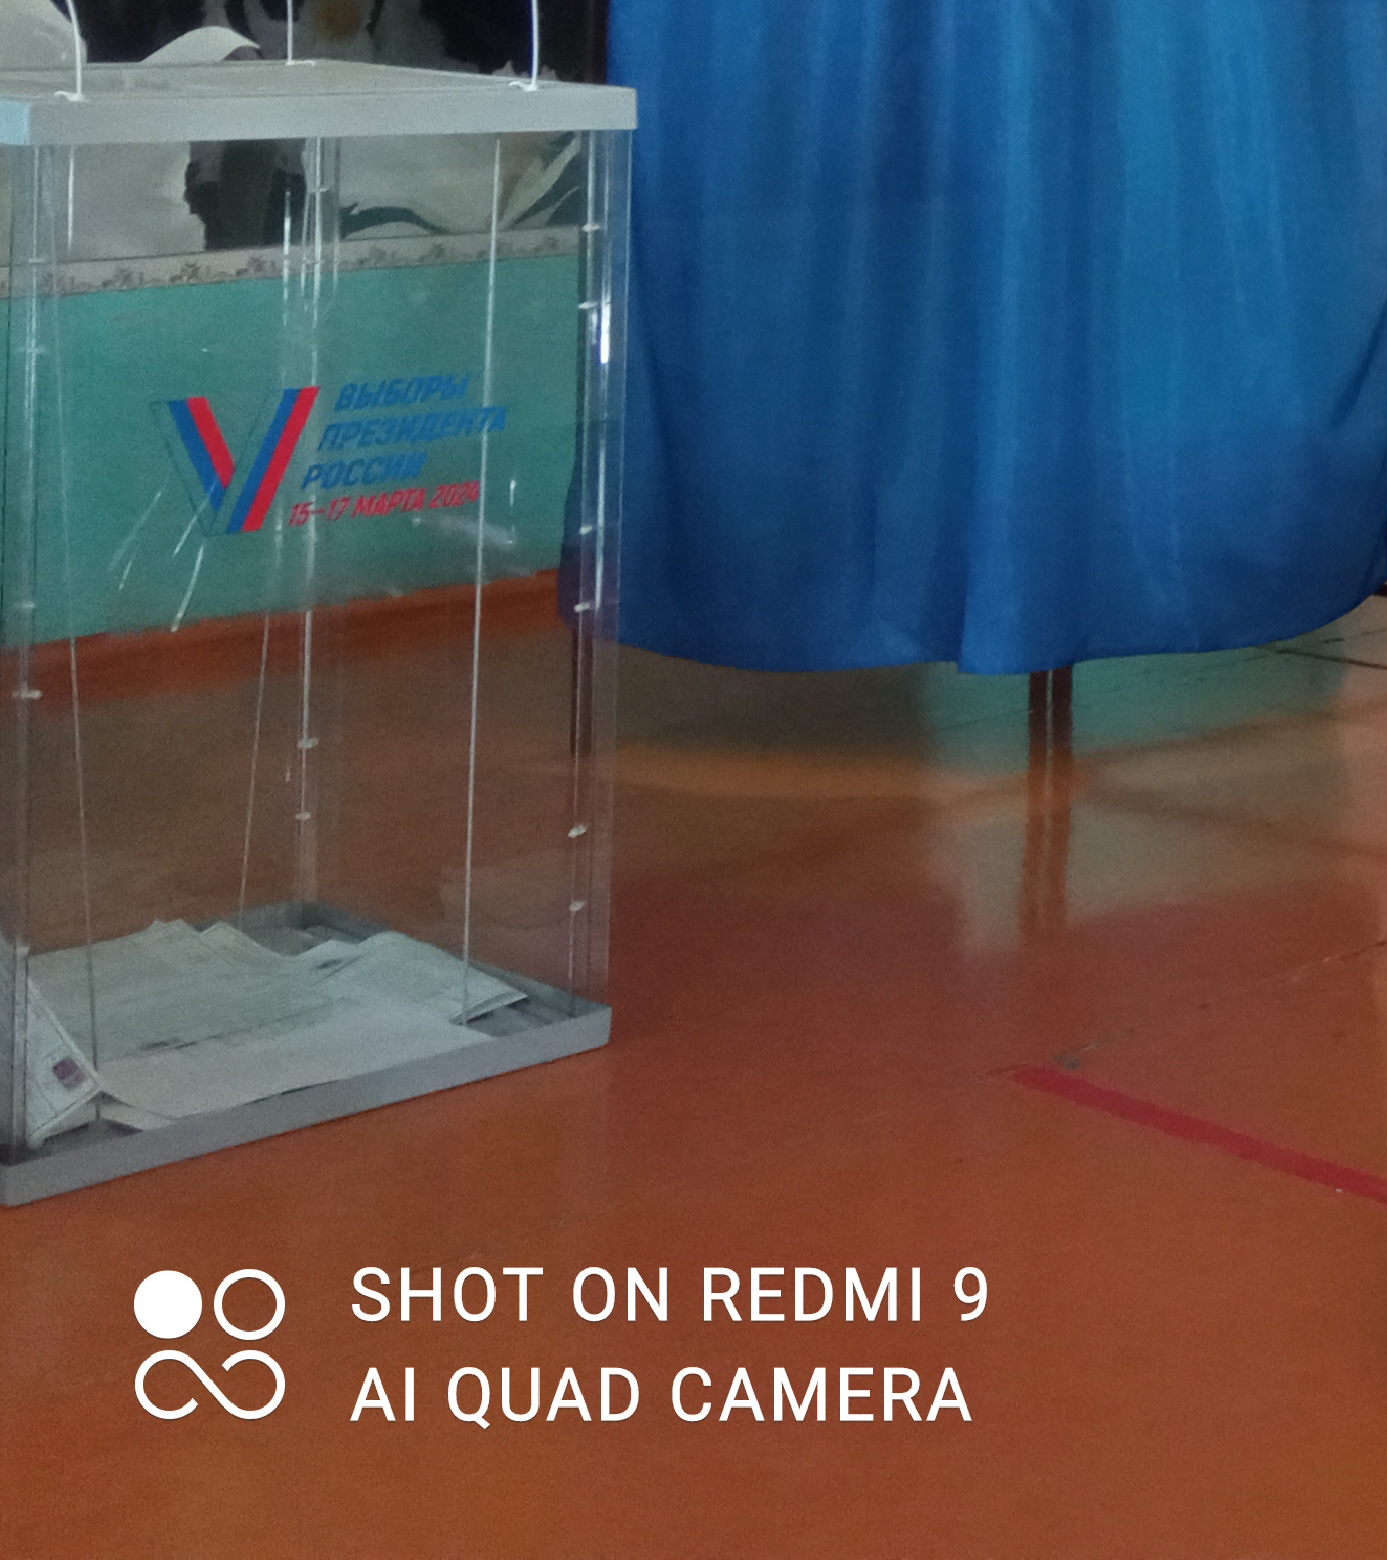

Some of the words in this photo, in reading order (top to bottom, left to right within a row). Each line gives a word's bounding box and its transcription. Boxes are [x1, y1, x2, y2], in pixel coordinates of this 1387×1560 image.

[334, 375, 471, 411] ВЫБОРЫ
[317, 406, 507, 451] ПРЕЗИДЕНТА
[300, 452, 428, 490] РОССИИ
[351, 488, 427, 518] МАРТА
[428, 480, 481, 509] 2024
